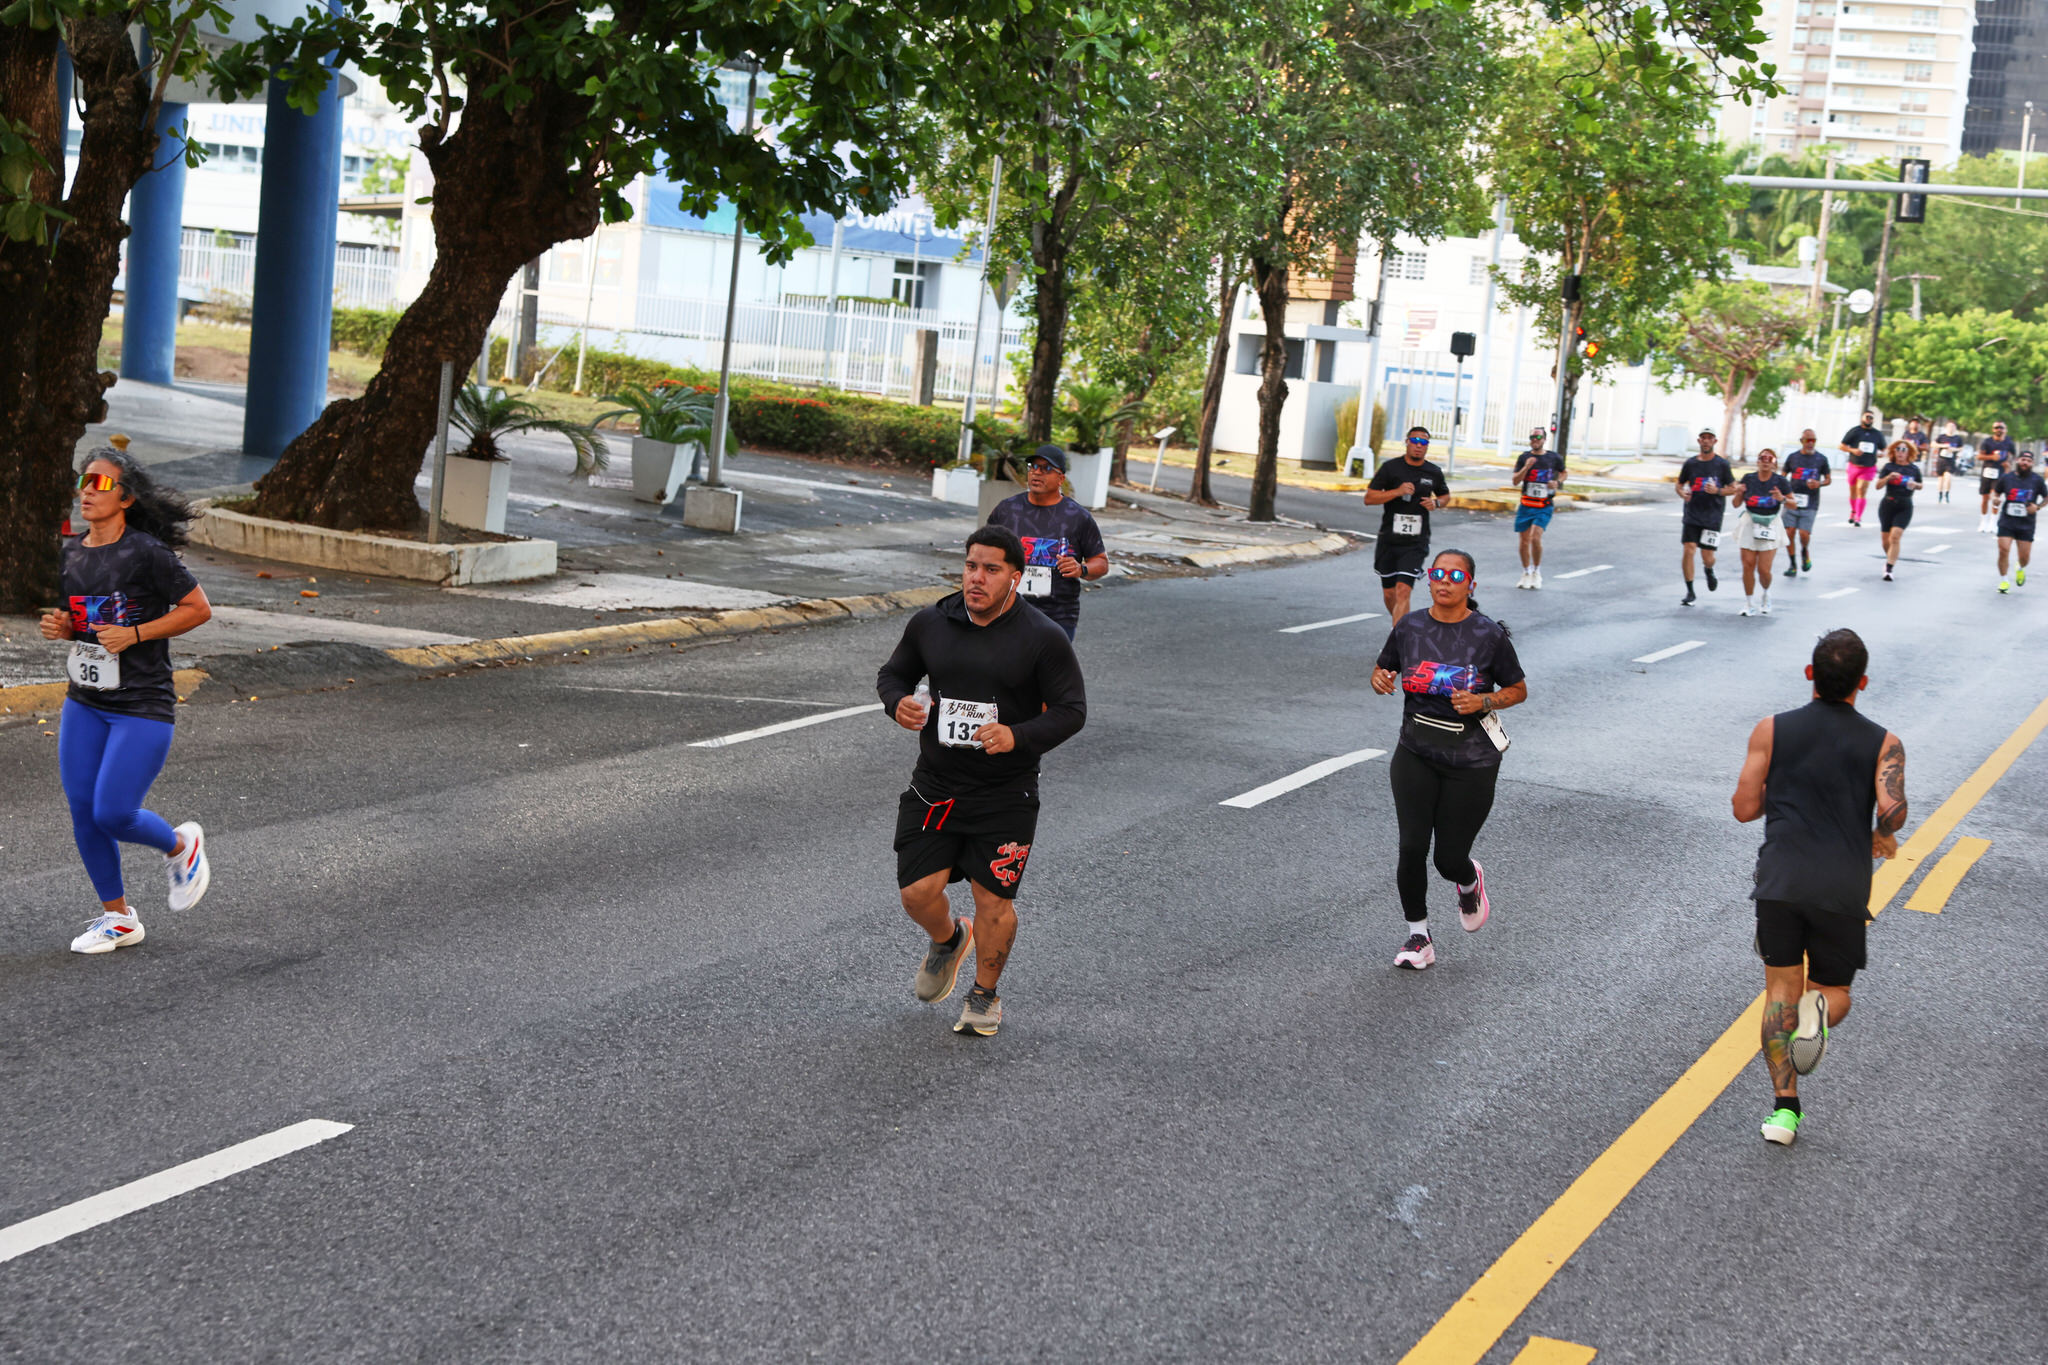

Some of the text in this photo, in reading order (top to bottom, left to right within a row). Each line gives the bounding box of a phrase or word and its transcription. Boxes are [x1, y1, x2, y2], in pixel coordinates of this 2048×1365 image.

[1402, 524, 1412, 532] 21
[1021, 536, 1059, 557] 5K
[1026, 580, 1032, 591] 1
[69, 595, 111, 622] 5K
[79, 663, 99, 683] 36
[1410, 660, 1465, 687] 5K
[956, 702, 979, 712] FADE
[966, 711, 986, 719] RUN
